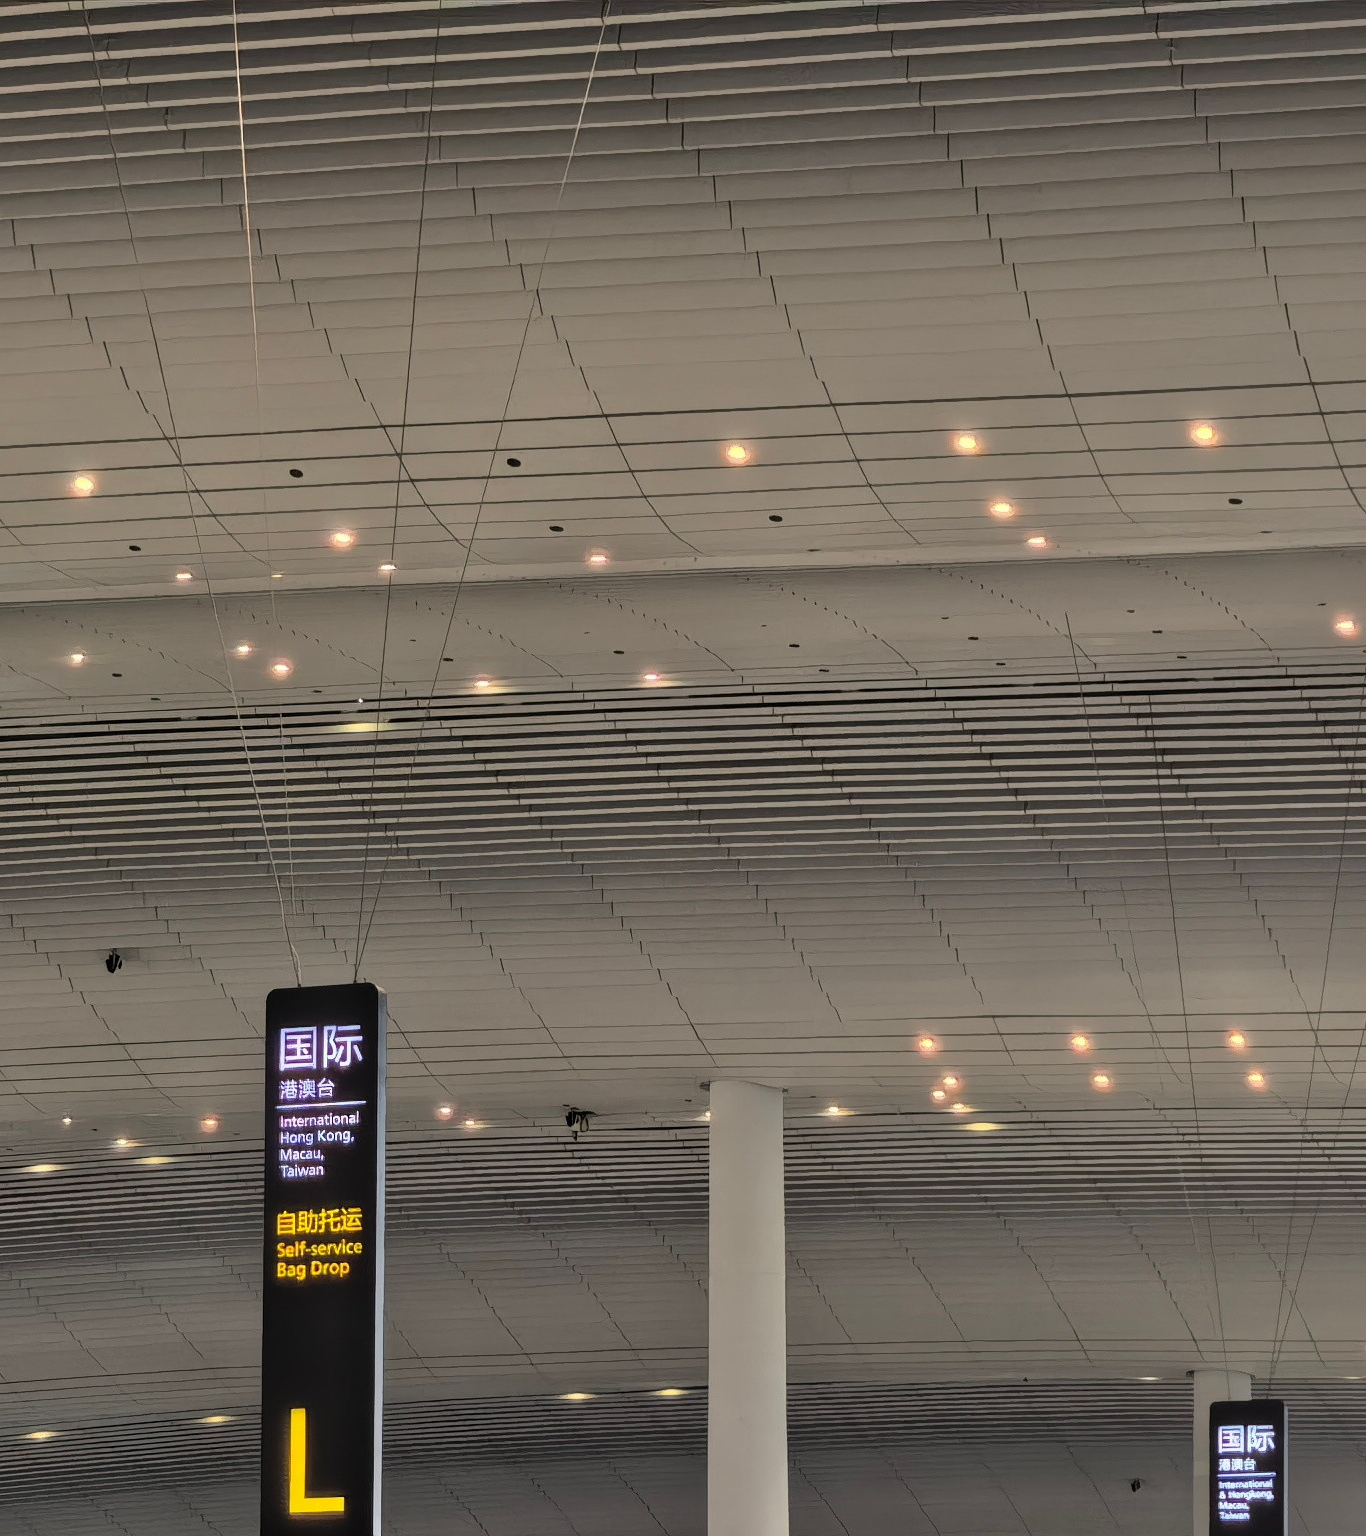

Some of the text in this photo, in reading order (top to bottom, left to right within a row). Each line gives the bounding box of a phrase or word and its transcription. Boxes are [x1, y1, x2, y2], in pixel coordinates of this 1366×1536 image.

[278, 1024, 363, 1071] 国际
[279, 1078, 335, 1100] 港澳台
[280, 1110, 360, 1128] International
[280, 1128, 355, 1146] Hong Kong,
[280, 1149, 325, 1162] Macau,
[280, 1165, 324, 1178] Taiwan
[276, 1207, 363, 1236] 自助托运
[276, 1239, 363, 1258] Self-service
[277, 1260, 350, 1281] Bag Drop
[1218, 1425, 1275, 1454] 国际
[289, 1408, 344, 1515] L
